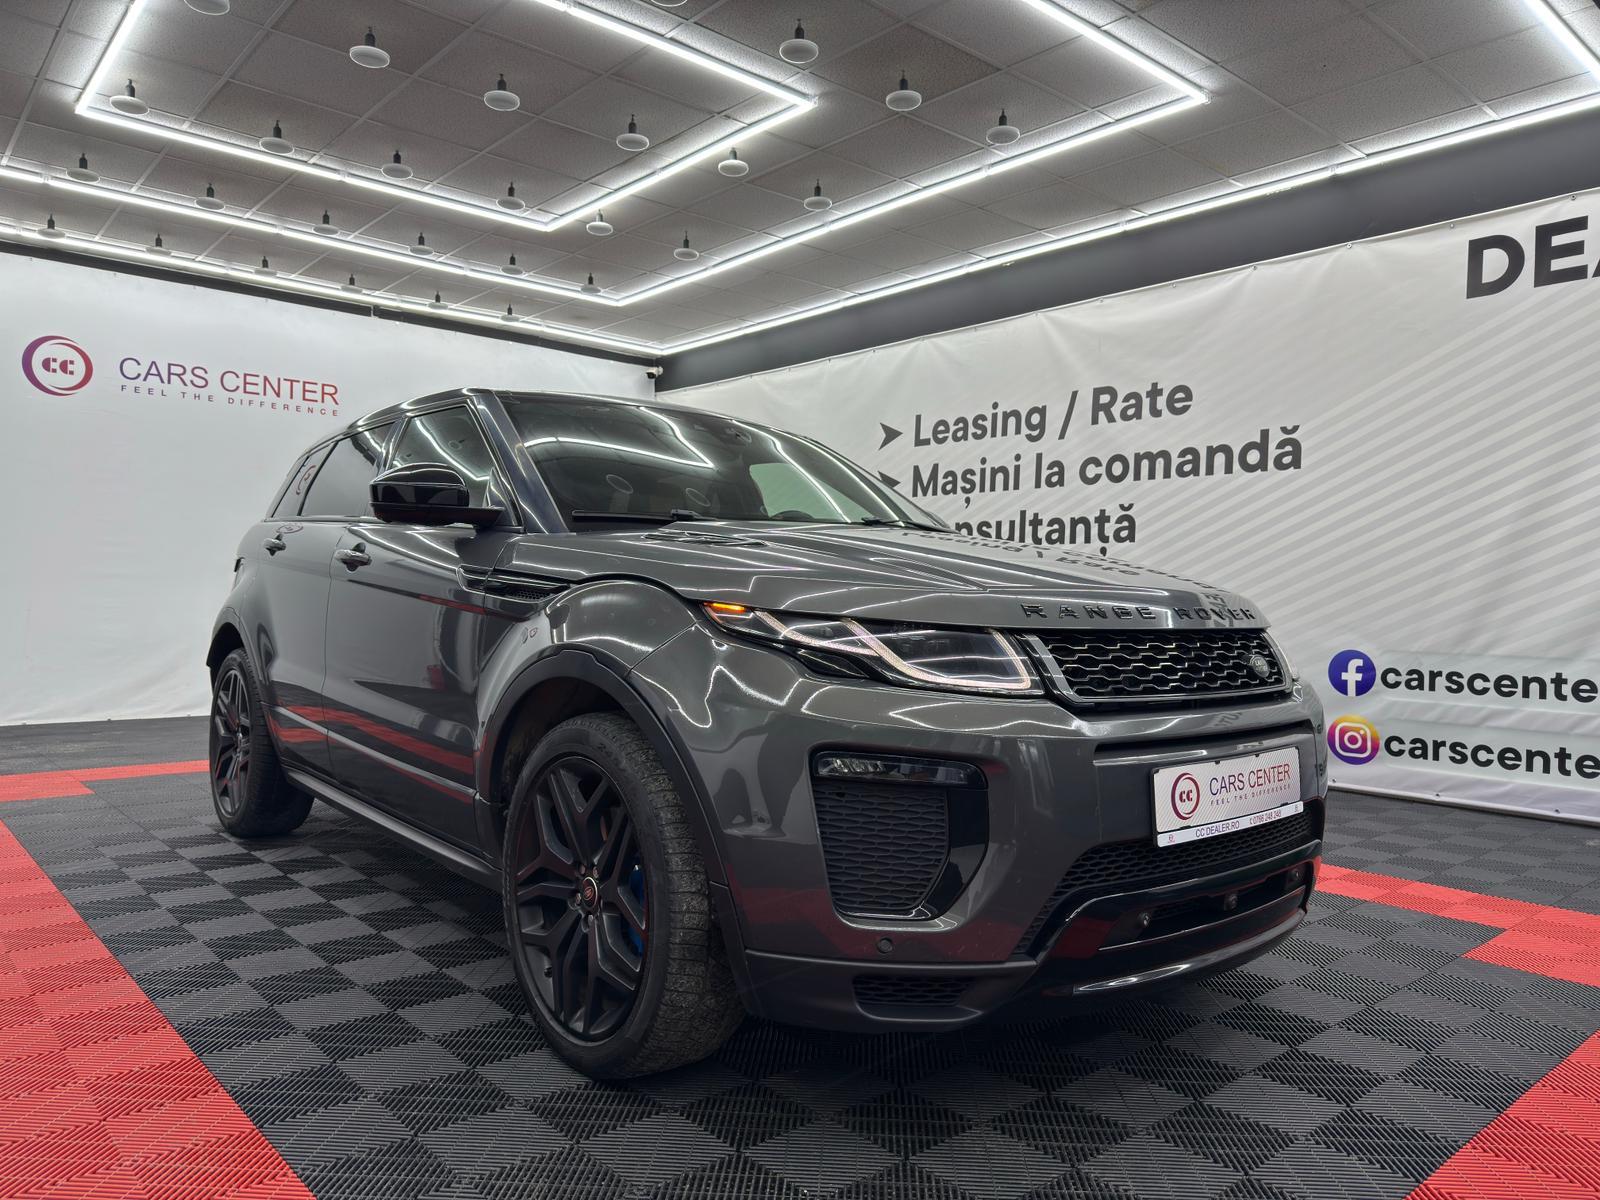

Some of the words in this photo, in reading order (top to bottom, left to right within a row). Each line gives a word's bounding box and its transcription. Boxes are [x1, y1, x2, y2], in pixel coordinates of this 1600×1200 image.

[1466, 215, 1600, 299] DE
[119, 357, 209, 388] CARS
[220, 370, 339, 405] CENTER
[121, 384, 167, 397] FEEL
[182, 391, 214, 403] THE
[228, 397, 339, 417] DIFFERENCE
[913, 401, 1047, 447] Leasing
[1058, 390, 1079, 440] /
[1091, 382, 1193, 425] Rate
[911, 453, 1021, 508] Mașini
[1035, 452, 1065, 489] la
[1079, 424, 1303, 484] comandă
[1021, 603, 1156, 619] RANGE
[1173, 607, 1256, 621] ROVER
[1209, 772, 1245, 796] CARS
[1248, 763, 1291, 788] CENTER
